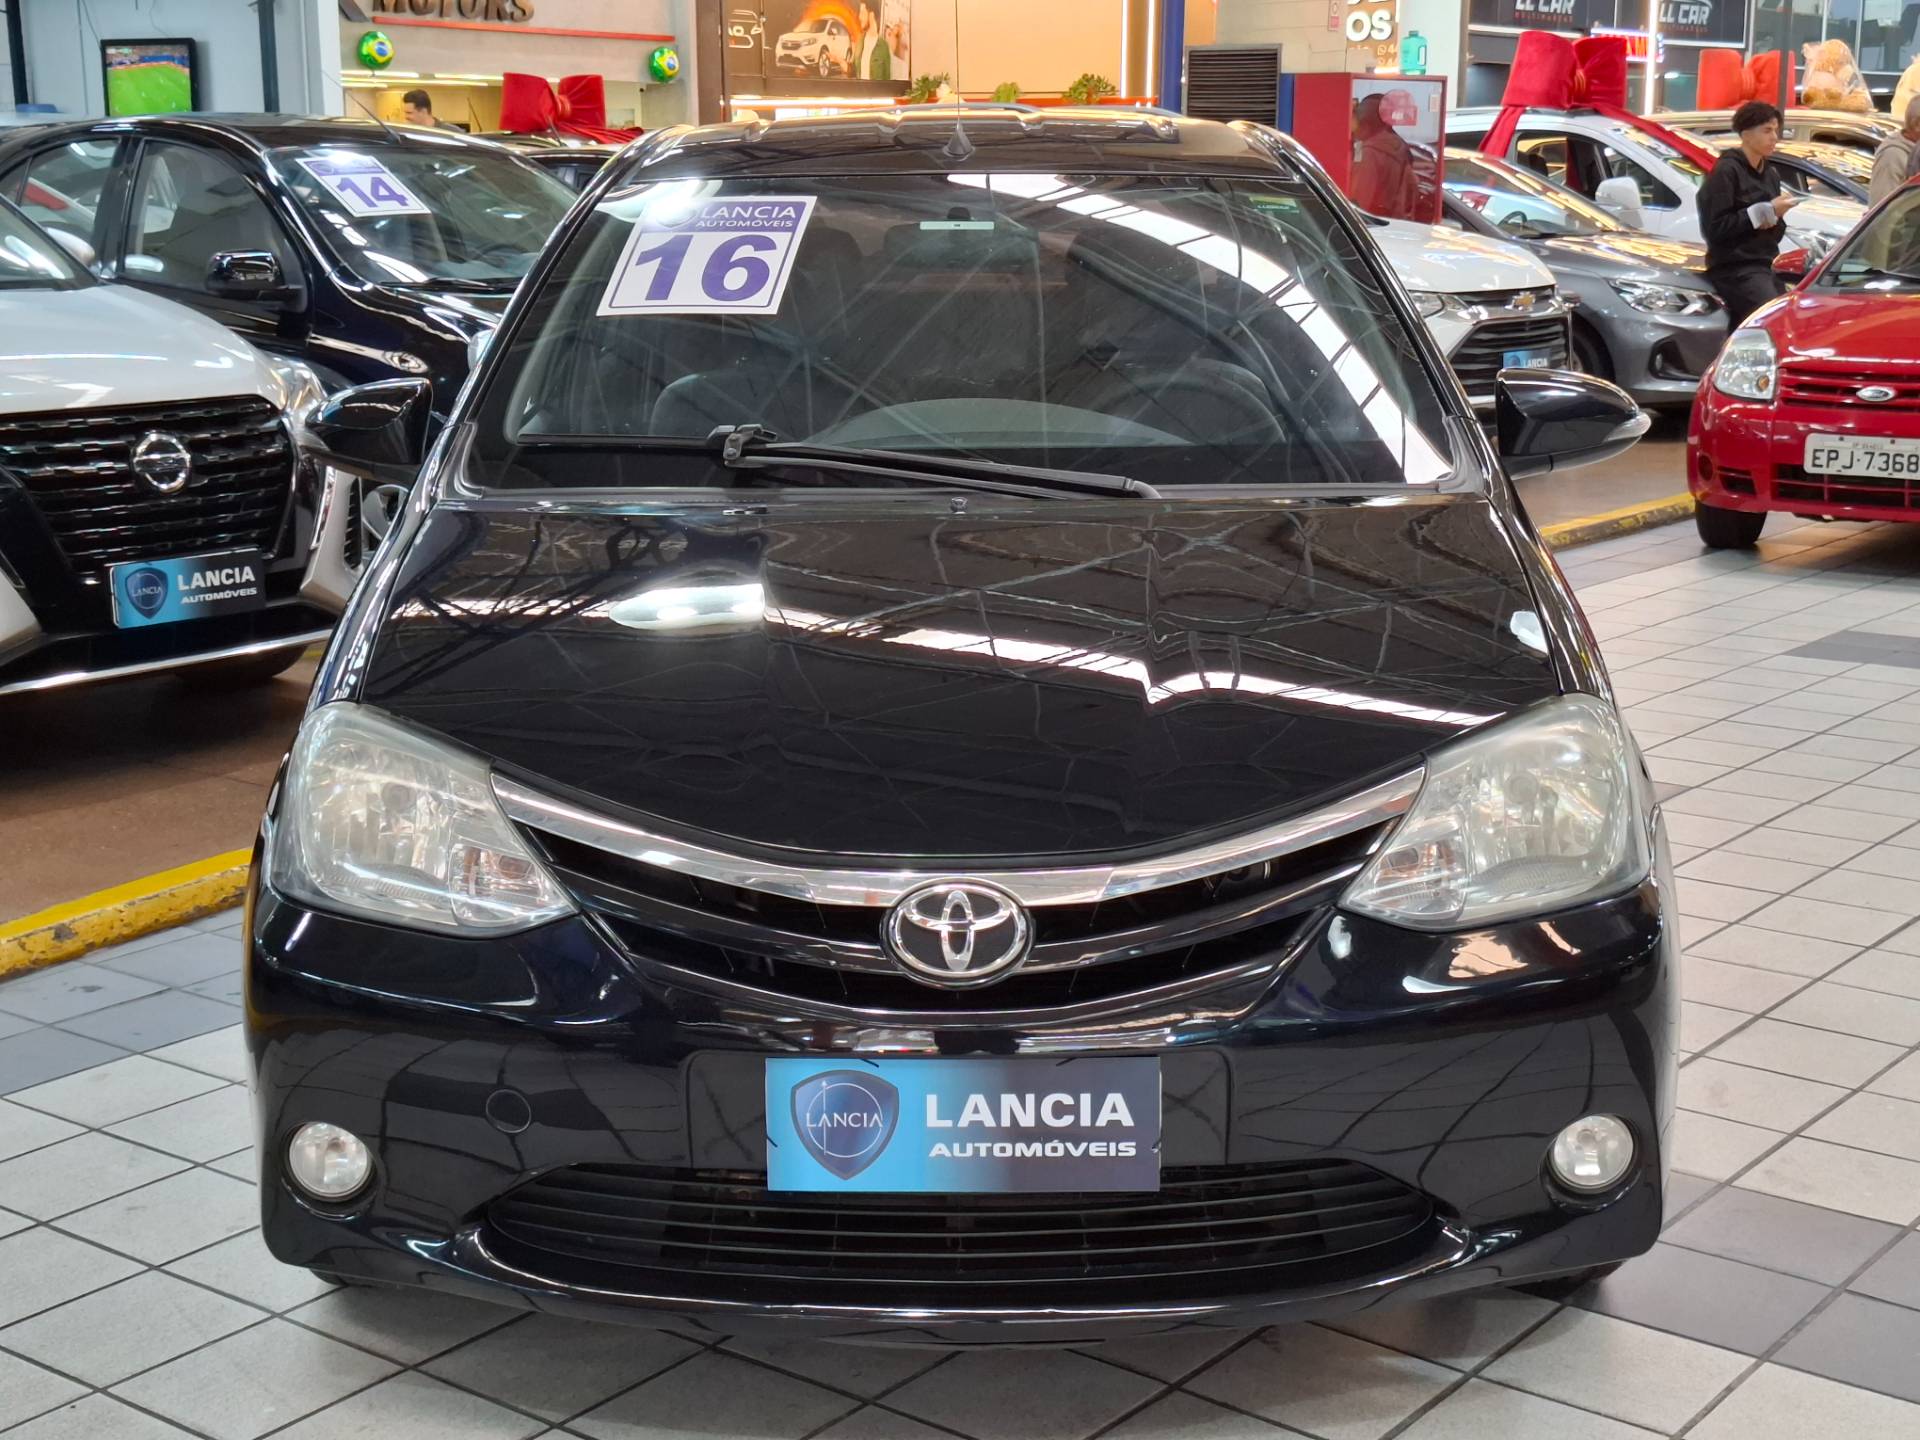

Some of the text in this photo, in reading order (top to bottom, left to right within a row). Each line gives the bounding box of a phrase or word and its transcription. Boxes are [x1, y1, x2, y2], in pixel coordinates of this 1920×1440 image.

[1538, 0, 1575, 15] CAR
[1678, 4, 1710, 25] CAR
[1346, 9, 1393, 42] OS
[336, 177, 408, 208] 14
[696, 218, 793, 228] AUTOMÓVEIS
[701, 206, 796, 219] LANCIA
[635, 234, 777, 302] 16
[177, 565, 256, 591] LANCIA
[180, 587, 258, 605] AUTOMÓVEIS
[806, 1112, 883, 1128] LANCIA
[926, 1092, 1134, 1128] LANCIA
[929, 1137, 1137, 1158] AUTOMÓVEIS
